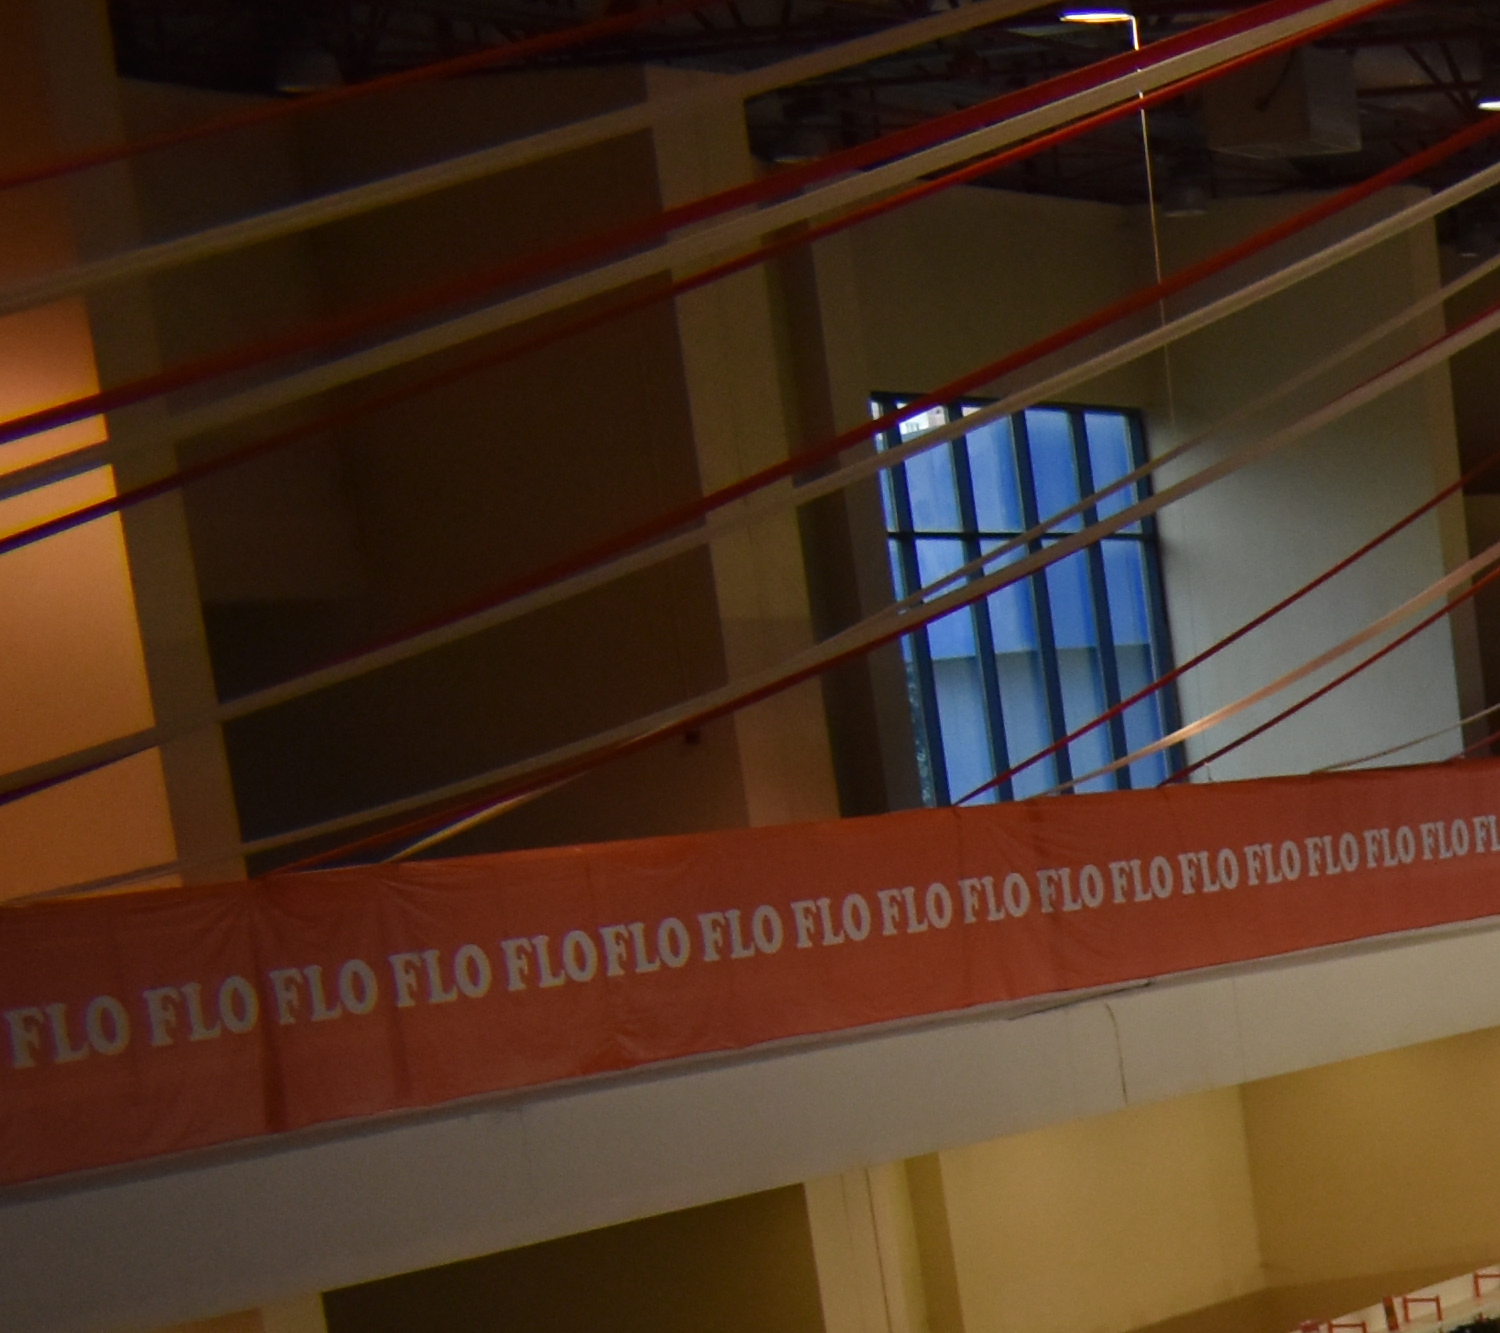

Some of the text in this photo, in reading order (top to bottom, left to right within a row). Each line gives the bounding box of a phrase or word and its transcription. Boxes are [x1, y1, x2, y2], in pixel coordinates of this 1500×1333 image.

[8, 996, 130, 1070] FLO
[144, 976, 258, 1047] FLO
[269, 959, 379, 1027] FLO
[388, 944, 492, 1010] FLO
[501, 930, 598, 992] FLO
[598, 916, 691, 977] FLO
[697, 903, 784, 963] FLO
[791, 892, 870, 948] FLO
[877, 882, 952, 937] FLO
[958, 872, 1030, 924] FLO
[1035, 863, 1104, 913] FLO
[1108, 855, 1173, 903] FLO
[1179, 847, 1238, 896] FLO
[1244, 839, 1300, 886] FLO
[1304, 831, 1359, 877] FLO
[1362, 825, 1415, 869] FLO
[1420, 821, 1469, 860] FLO
